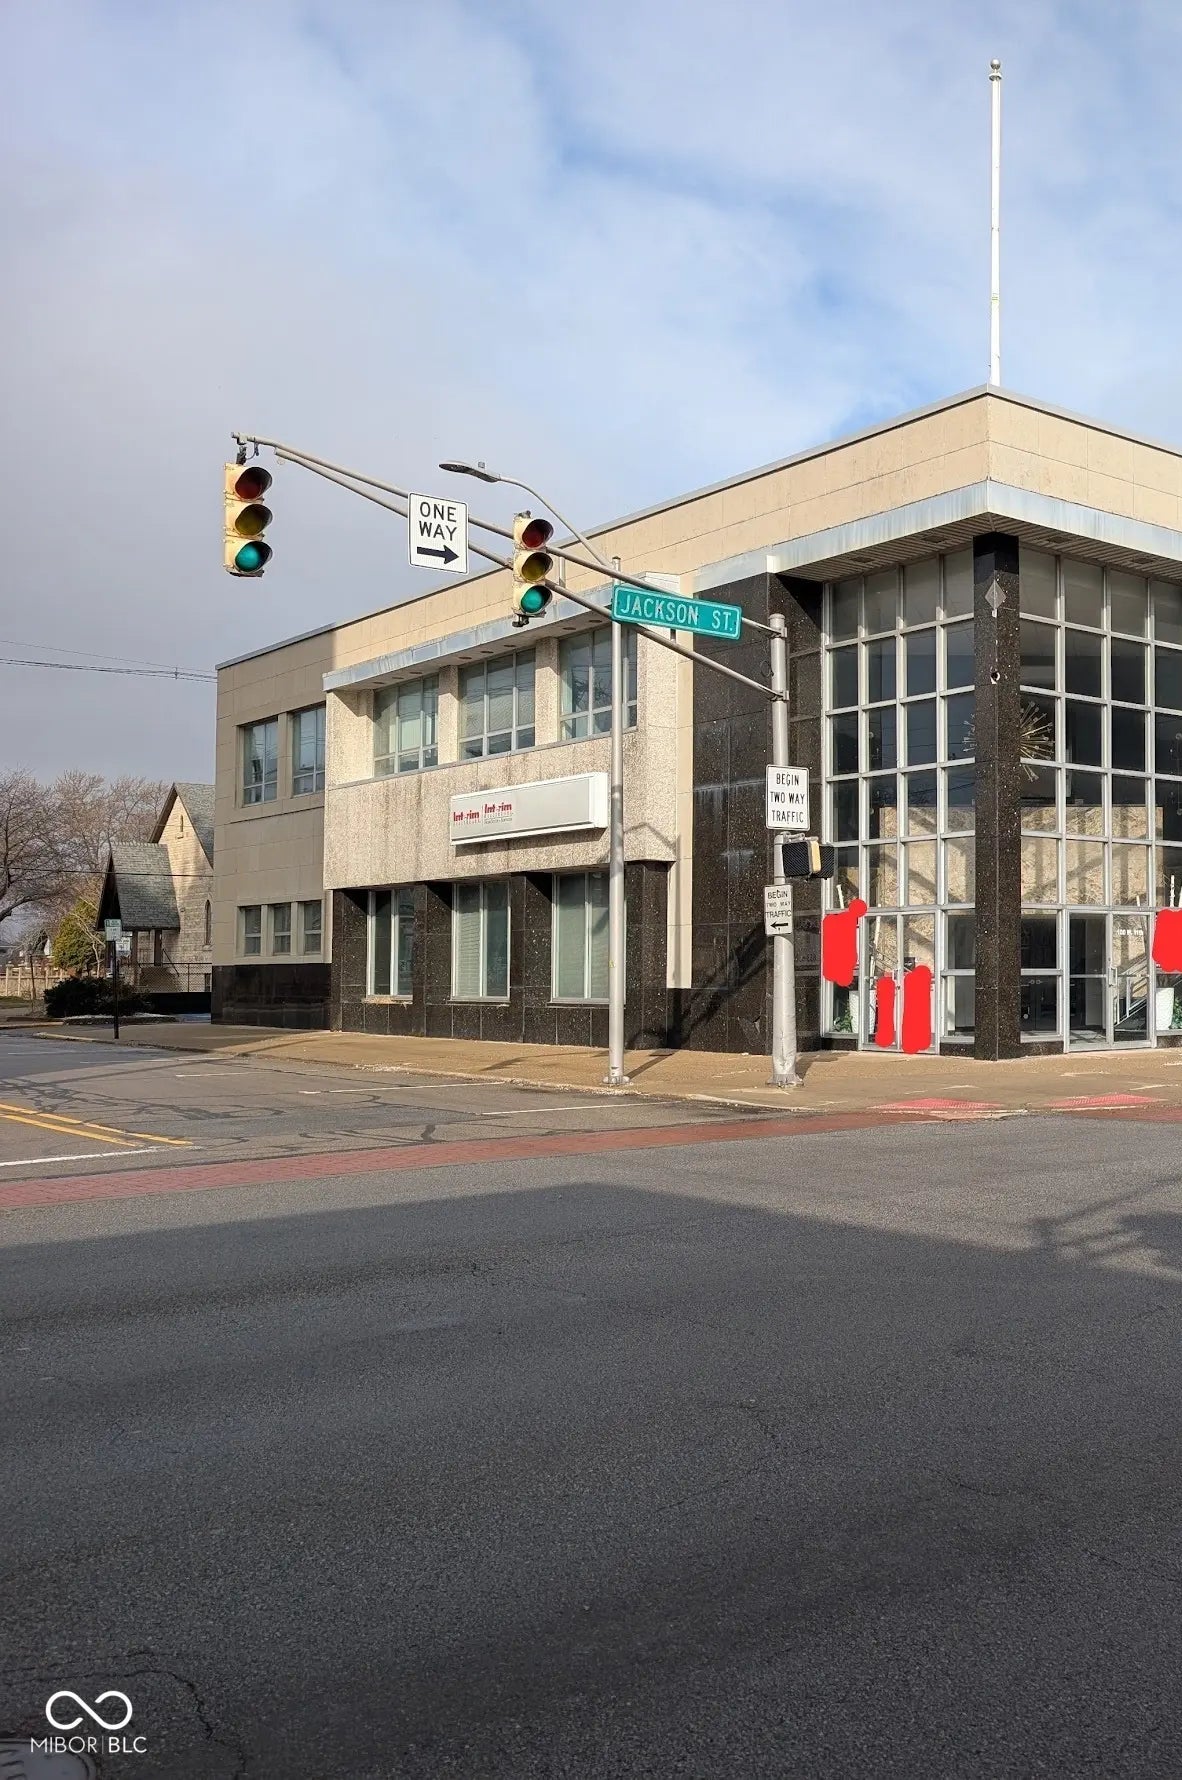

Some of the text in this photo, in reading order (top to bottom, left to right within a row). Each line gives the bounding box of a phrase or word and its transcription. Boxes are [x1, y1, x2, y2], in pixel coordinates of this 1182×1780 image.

[419, 501, 457, 523] ONE
[418, 520, 458, 542] WAY
[620, 594, 733, 631] JACKSON ST.
[776, 773, 800, 786] BEGIN
[770, 791, 805, 805] TWO WAY
[771, 809, 804, 823] TRAFFIC
[767, 890, 788, 899] BEGIN
[765, 910, 792, 918] TRAFFIC
